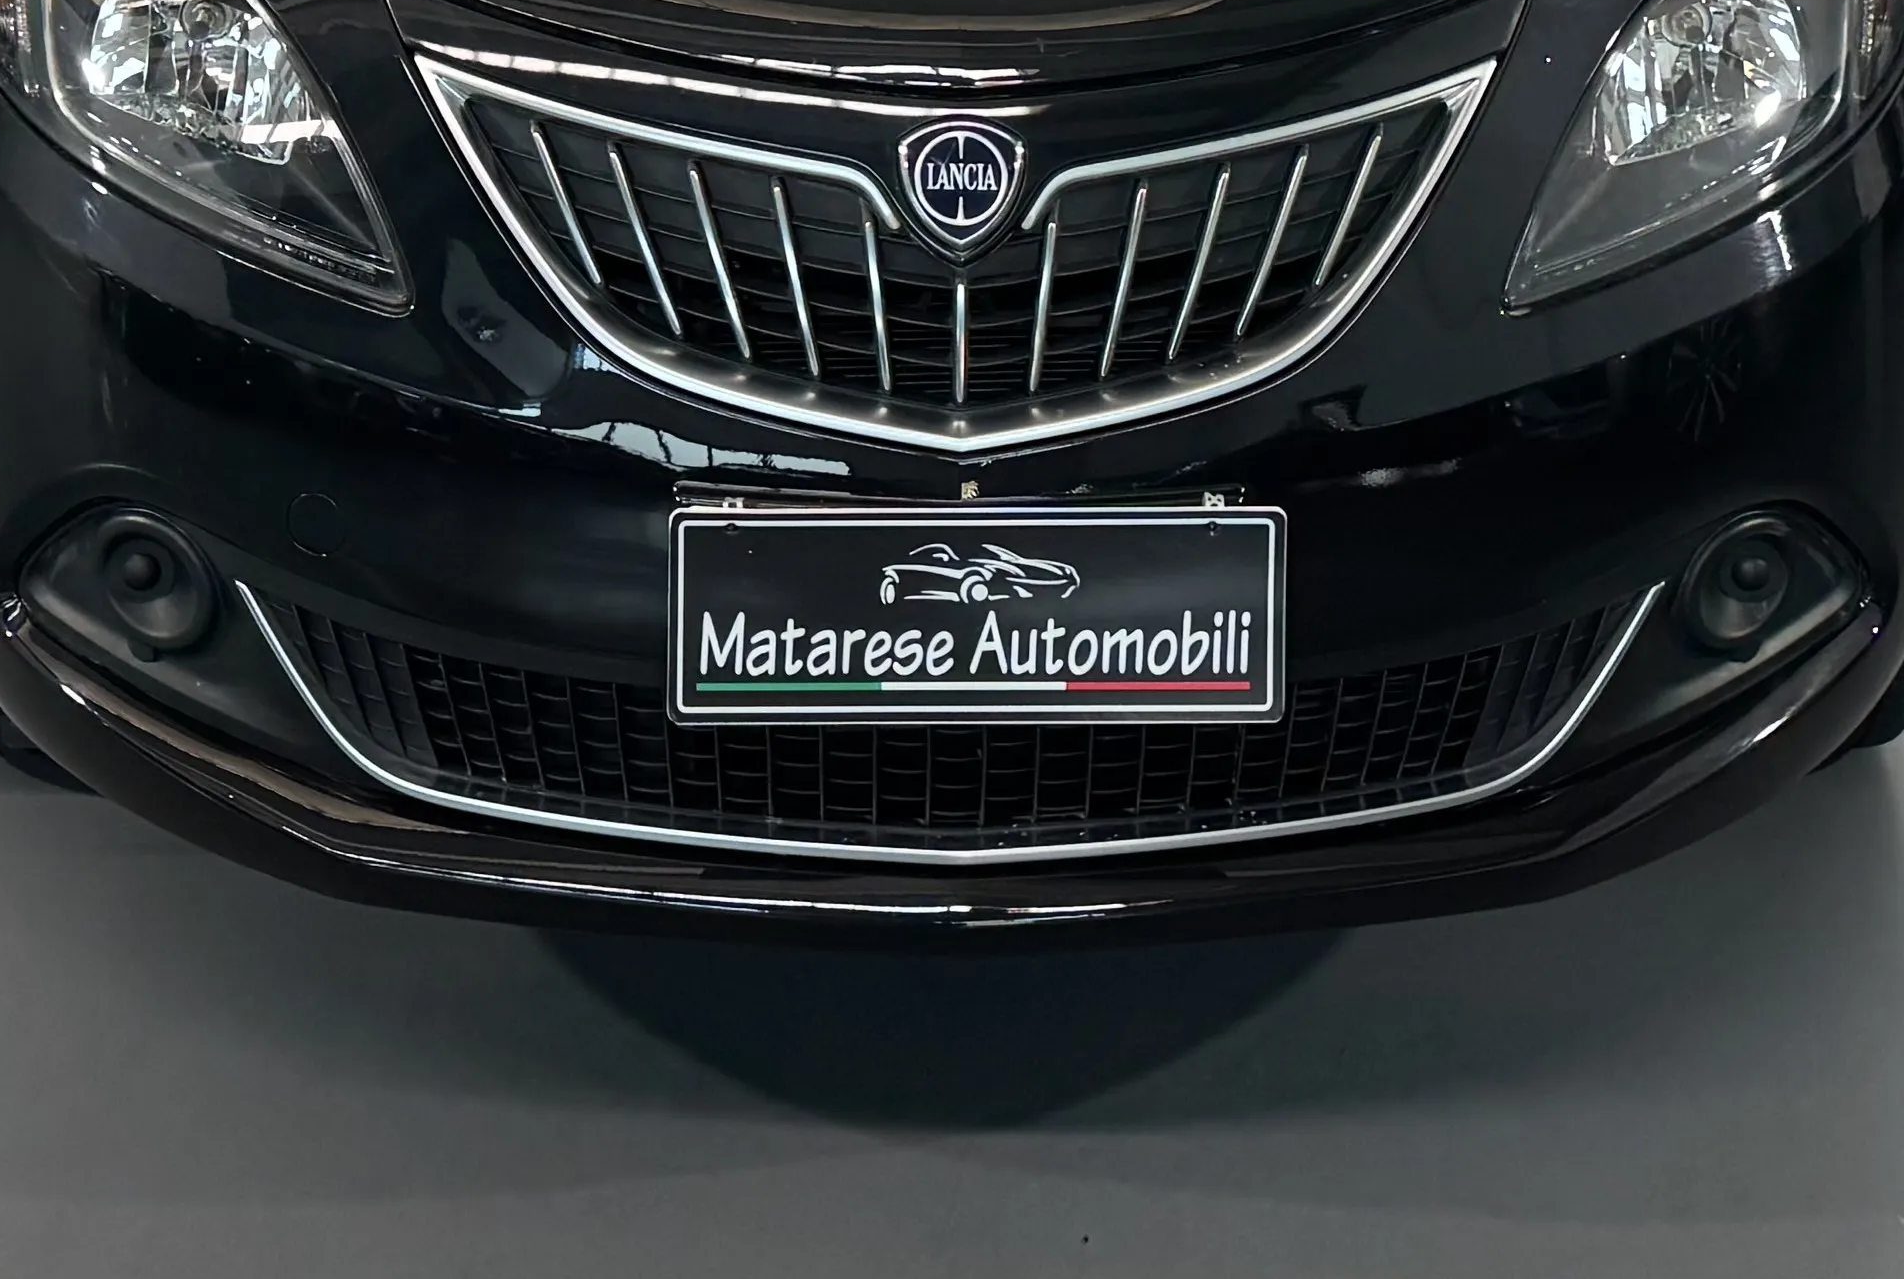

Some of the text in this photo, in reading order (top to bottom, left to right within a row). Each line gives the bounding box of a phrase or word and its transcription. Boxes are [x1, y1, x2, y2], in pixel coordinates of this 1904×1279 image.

[926, 162, 998, 191] LANCIA
[699, 610, 1252, 676] Matarese Automobili
